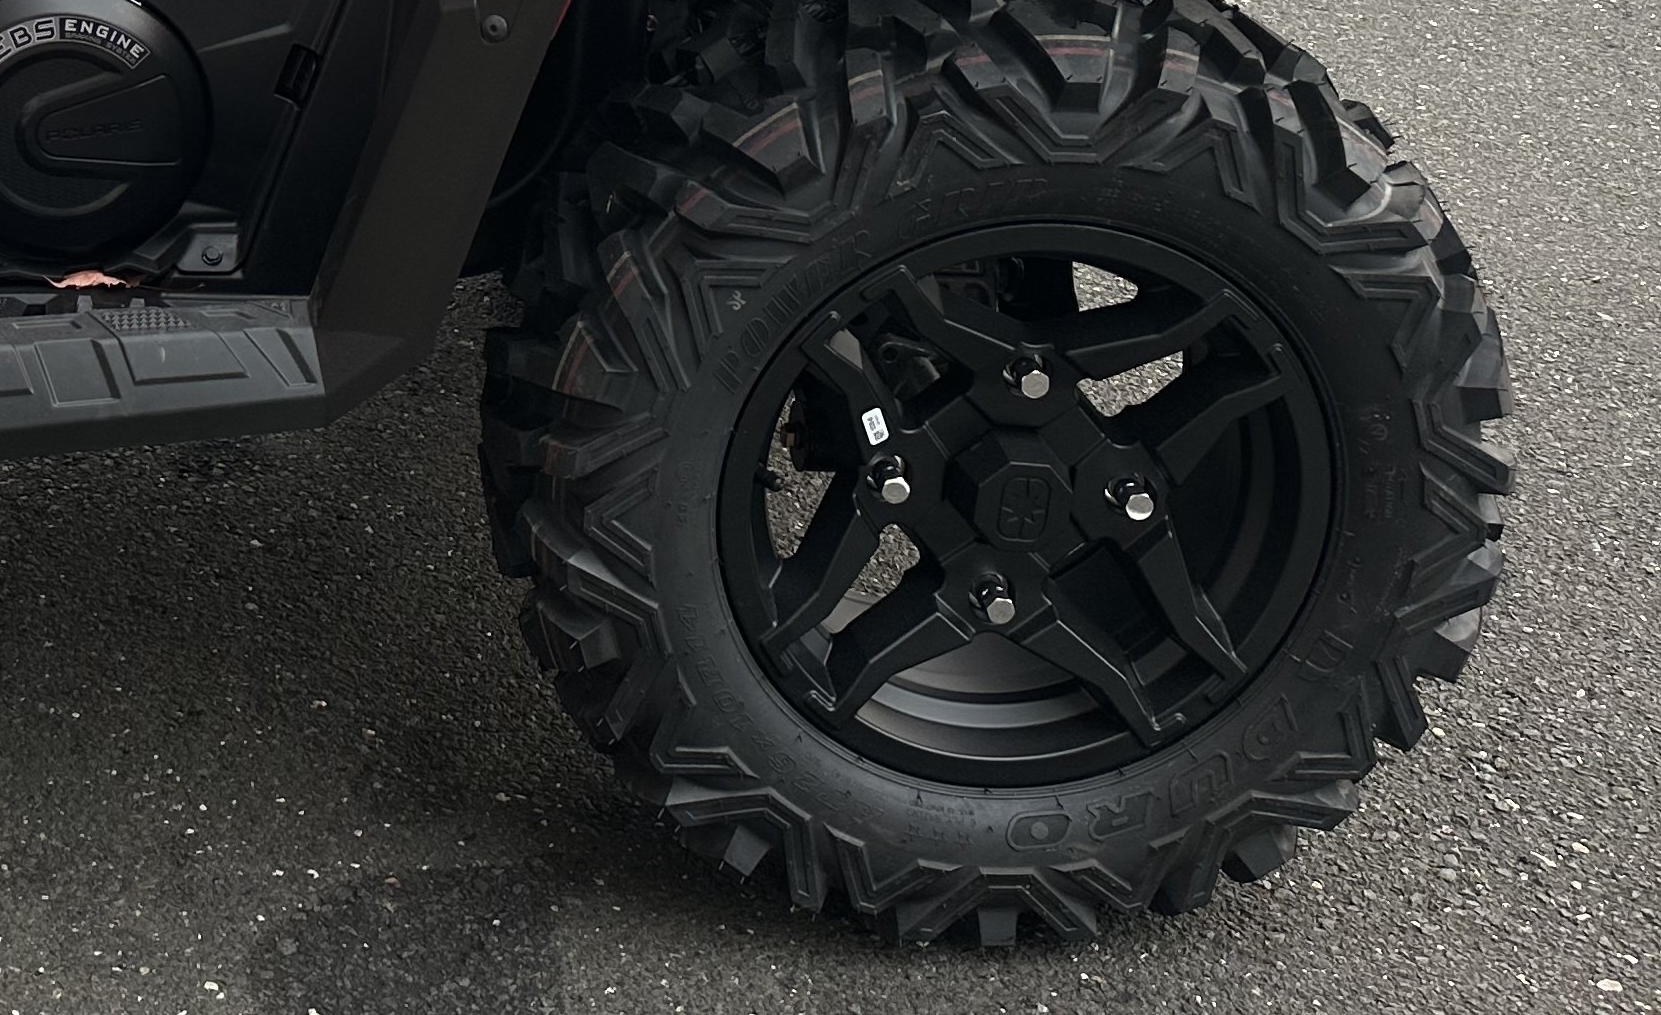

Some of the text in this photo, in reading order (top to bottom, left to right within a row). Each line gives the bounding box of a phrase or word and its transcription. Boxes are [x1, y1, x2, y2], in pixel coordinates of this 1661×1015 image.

[64, 18, 145, 59] ENGINE
[44, 120, 144, 143] POLARIS
[714, 226, 873, 394] POWER
[1006, 692, 1302, 852] DURO
